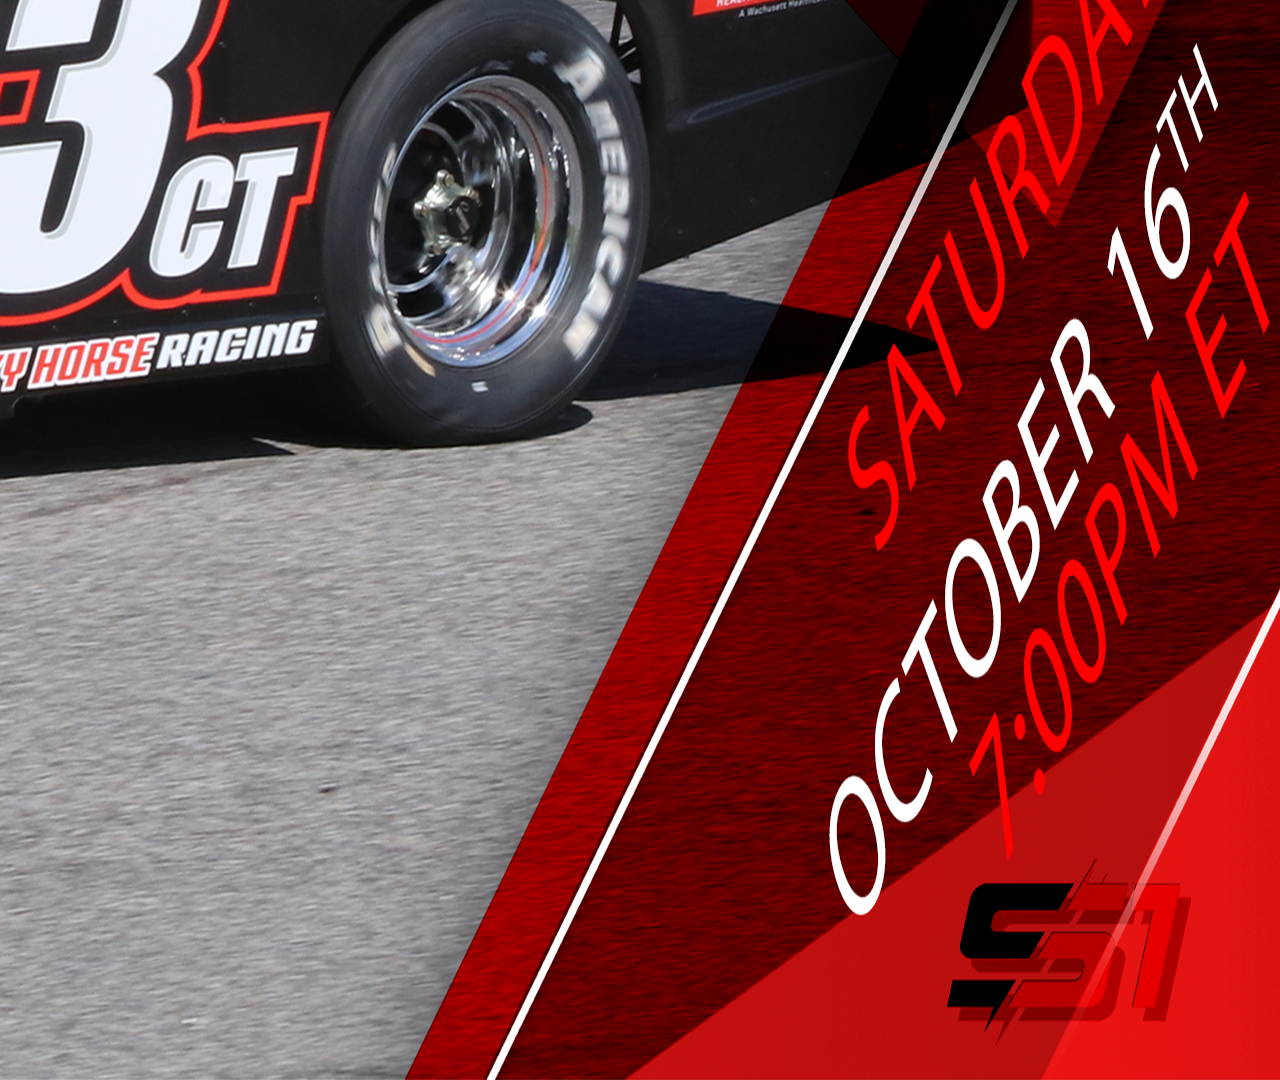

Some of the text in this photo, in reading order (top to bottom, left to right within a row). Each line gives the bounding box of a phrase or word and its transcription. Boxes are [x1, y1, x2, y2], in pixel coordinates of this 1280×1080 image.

[746, 1, 788, 17] Wachusett
[31, 333, 157, 390] HORSE
[156, 319, 318, 369] RACING
